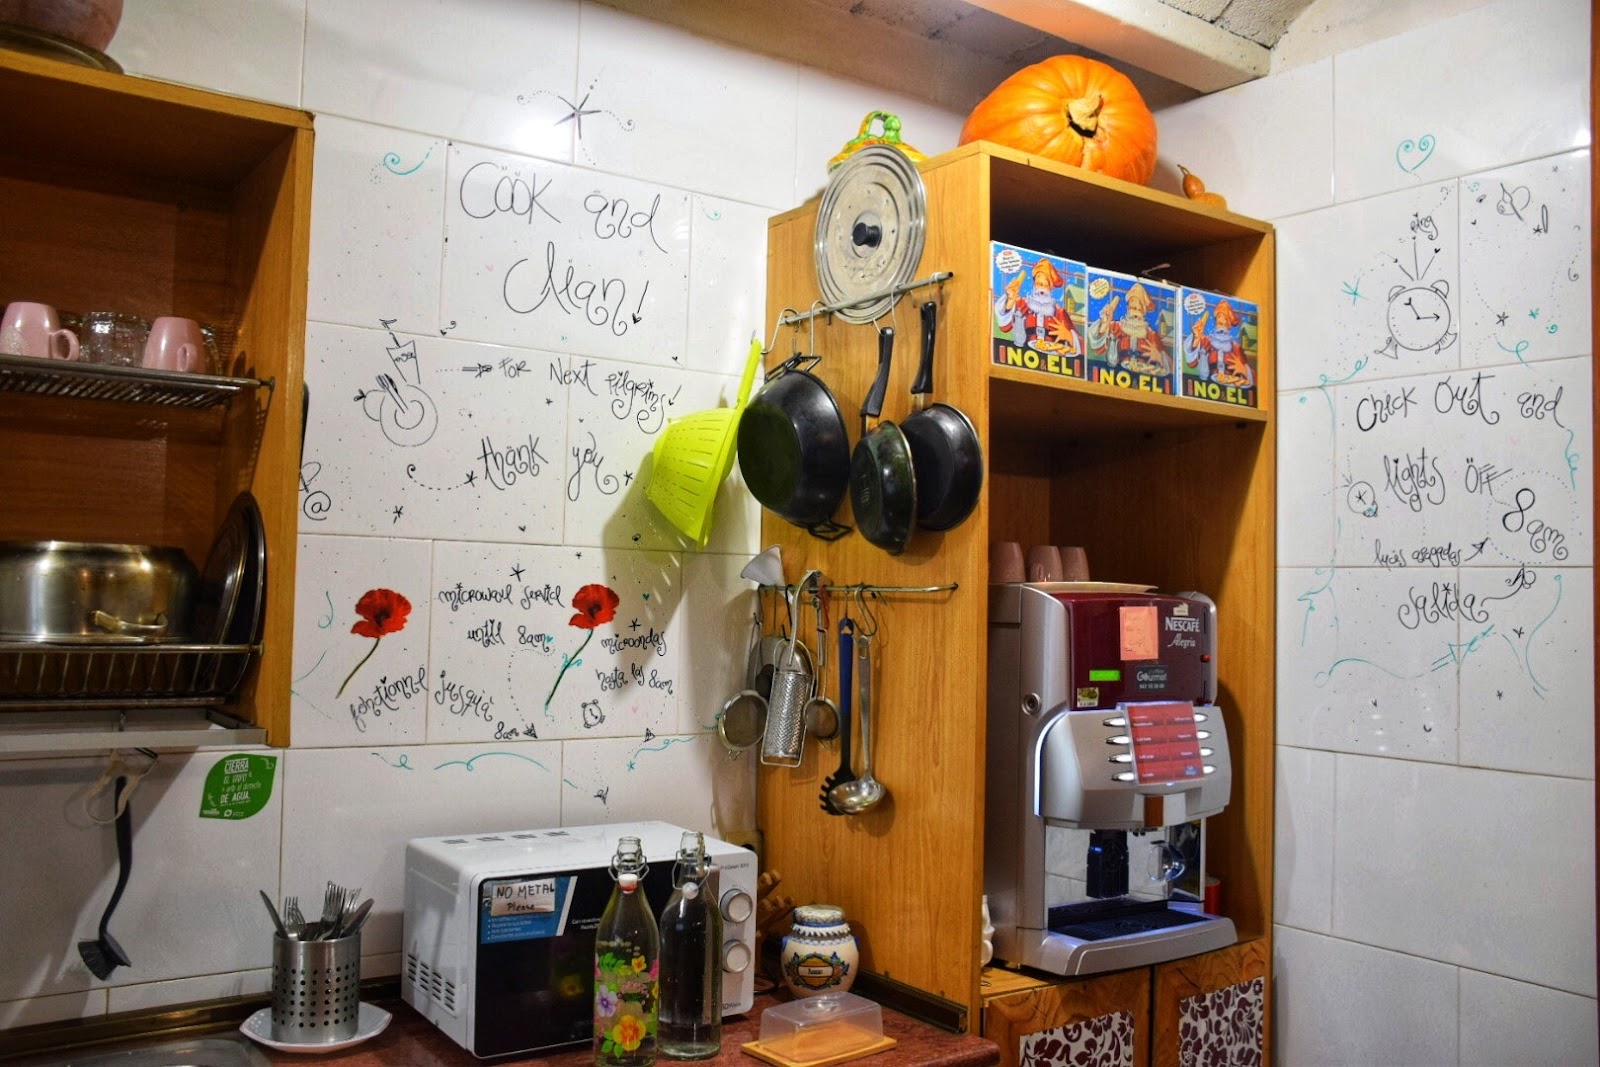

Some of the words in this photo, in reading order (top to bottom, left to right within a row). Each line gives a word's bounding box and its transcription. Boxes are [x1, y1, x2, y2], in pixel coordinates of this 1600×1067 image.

[550, 357, 598, 396] Next
[1516, 386, 1565, 429] and
[567, 431, 620, 502] you
[1165, 616, 1200, 633] NESCAFÉ
[595, 666, 629, 692] hasta
[631, 662, 645, 687] las
[224, 759, 249, 773] CIERRA
[220, 793, 229, 803] DE
[496, 886, 513, 899] NO
[517, 882, 555, 900] METAL
[507, 902, 535, 912] Please
